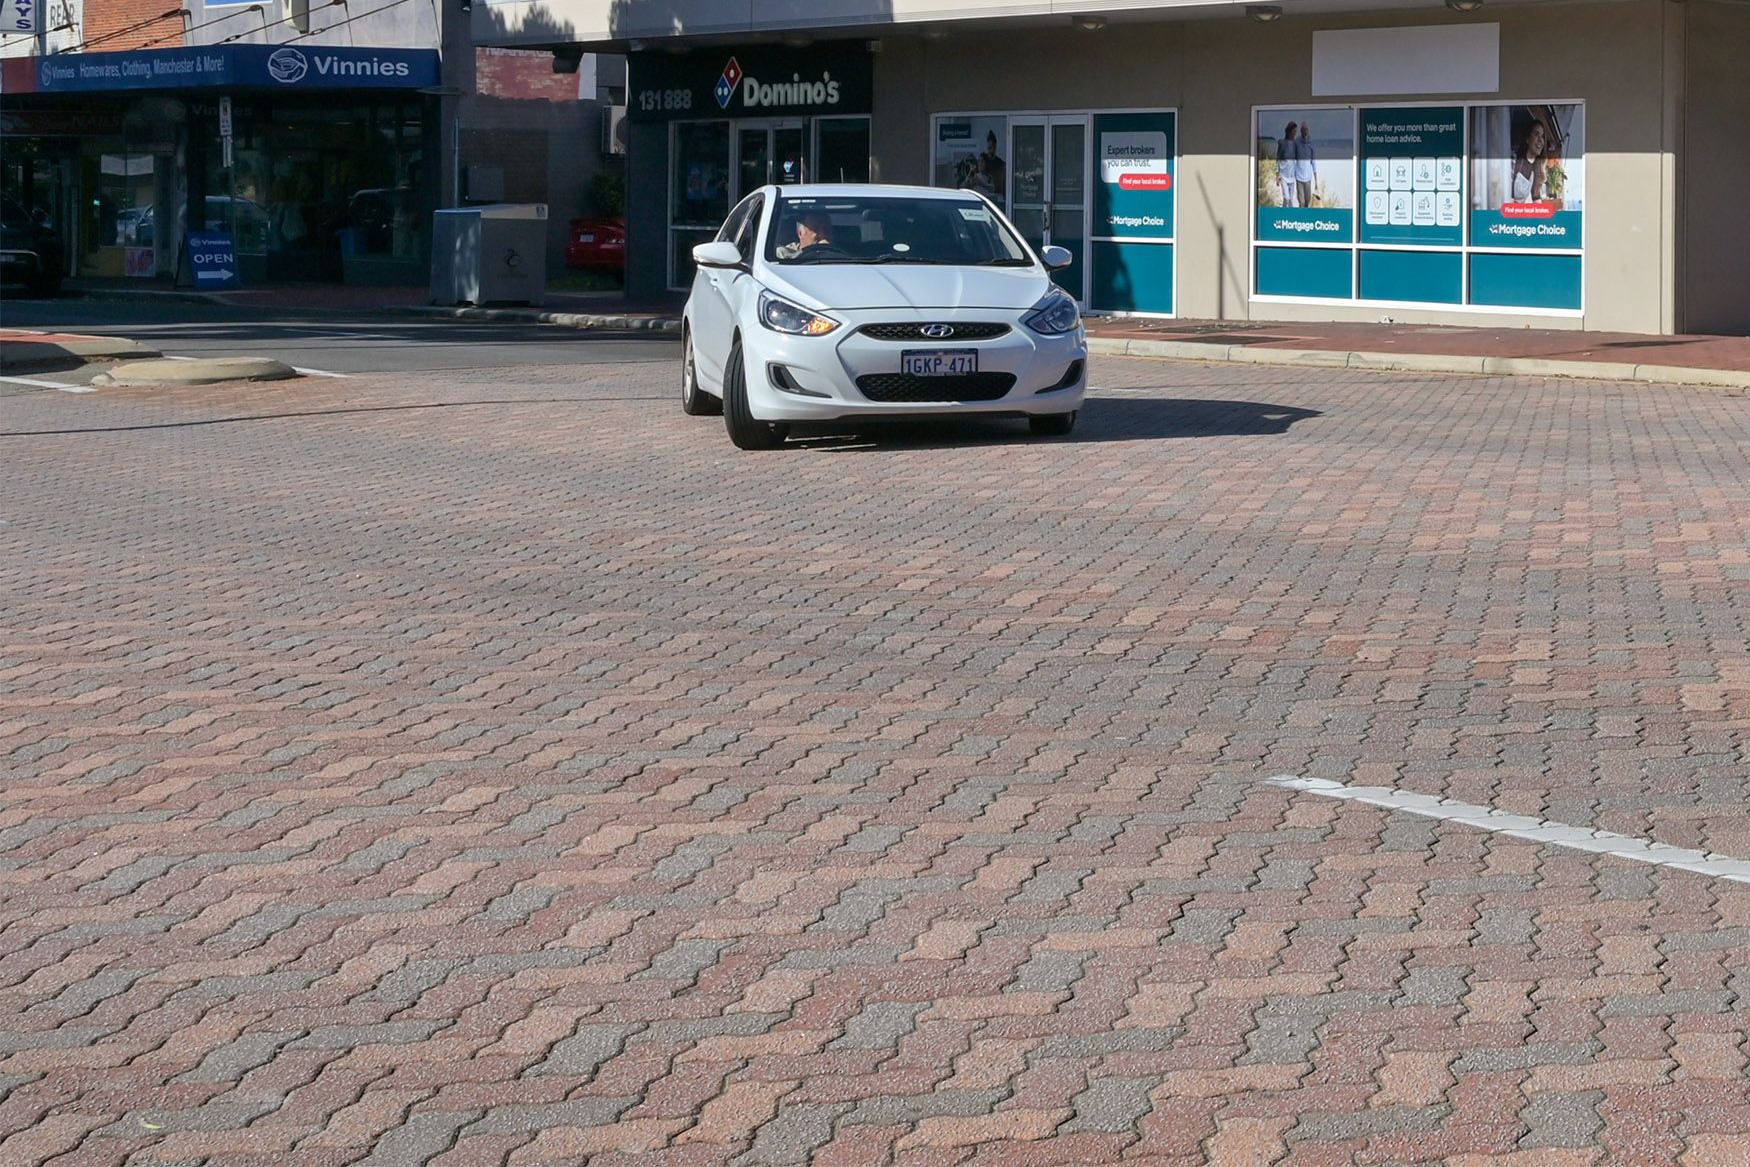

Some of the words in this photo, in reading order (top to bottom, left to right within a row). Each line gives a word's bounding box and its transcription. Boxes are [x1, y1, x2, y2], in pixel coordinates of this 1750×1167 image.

[80, 62, 121, 80] Homewares,
[122, 60, 151, 79] Clothing,
[153, 57, 195, 74] Manchester
[195, 58, 202, 71] &
[203, 55, 225, 72] More!
[313, 55, 410, 76] Vinnies
[52, 65, 75, 80] Vinnies
[743, 70, 840, 107] Domino's
[192, 103, 253, 117] Vines
[1366, 123, 1377, 131] We
[1377, 123, 1393, 131] offer
[1394, 125, 1406, 133] you
[1423, 123, 1438, 131] than
[1439, 123, 1456, 133] great
[1366, 135, 1384, 143] home
[1385, 135, 1399, 143] loan
[1400, 134, 1422, 143] advice.
[1107, 145, 1129, 156] Expert
[1131, 145, 1155, 154] brokers
[1107, 160, 1119, 168] you
[1121, 159, 1133, 167] can
[1134, 159, 1151, 167] trust.
[1113, 216, 1141, 227] Mortgage
[1142, 216, 1164, 226] Choice
[1281, 219, 1314, 232] Mortgage
[1314, 220, 1340, 231] Choice
[1499, 223, 1537, 237] Mortgage
[1537, 224, 1566, 235] Choice
[193, 253, 234, 264] OPEN
